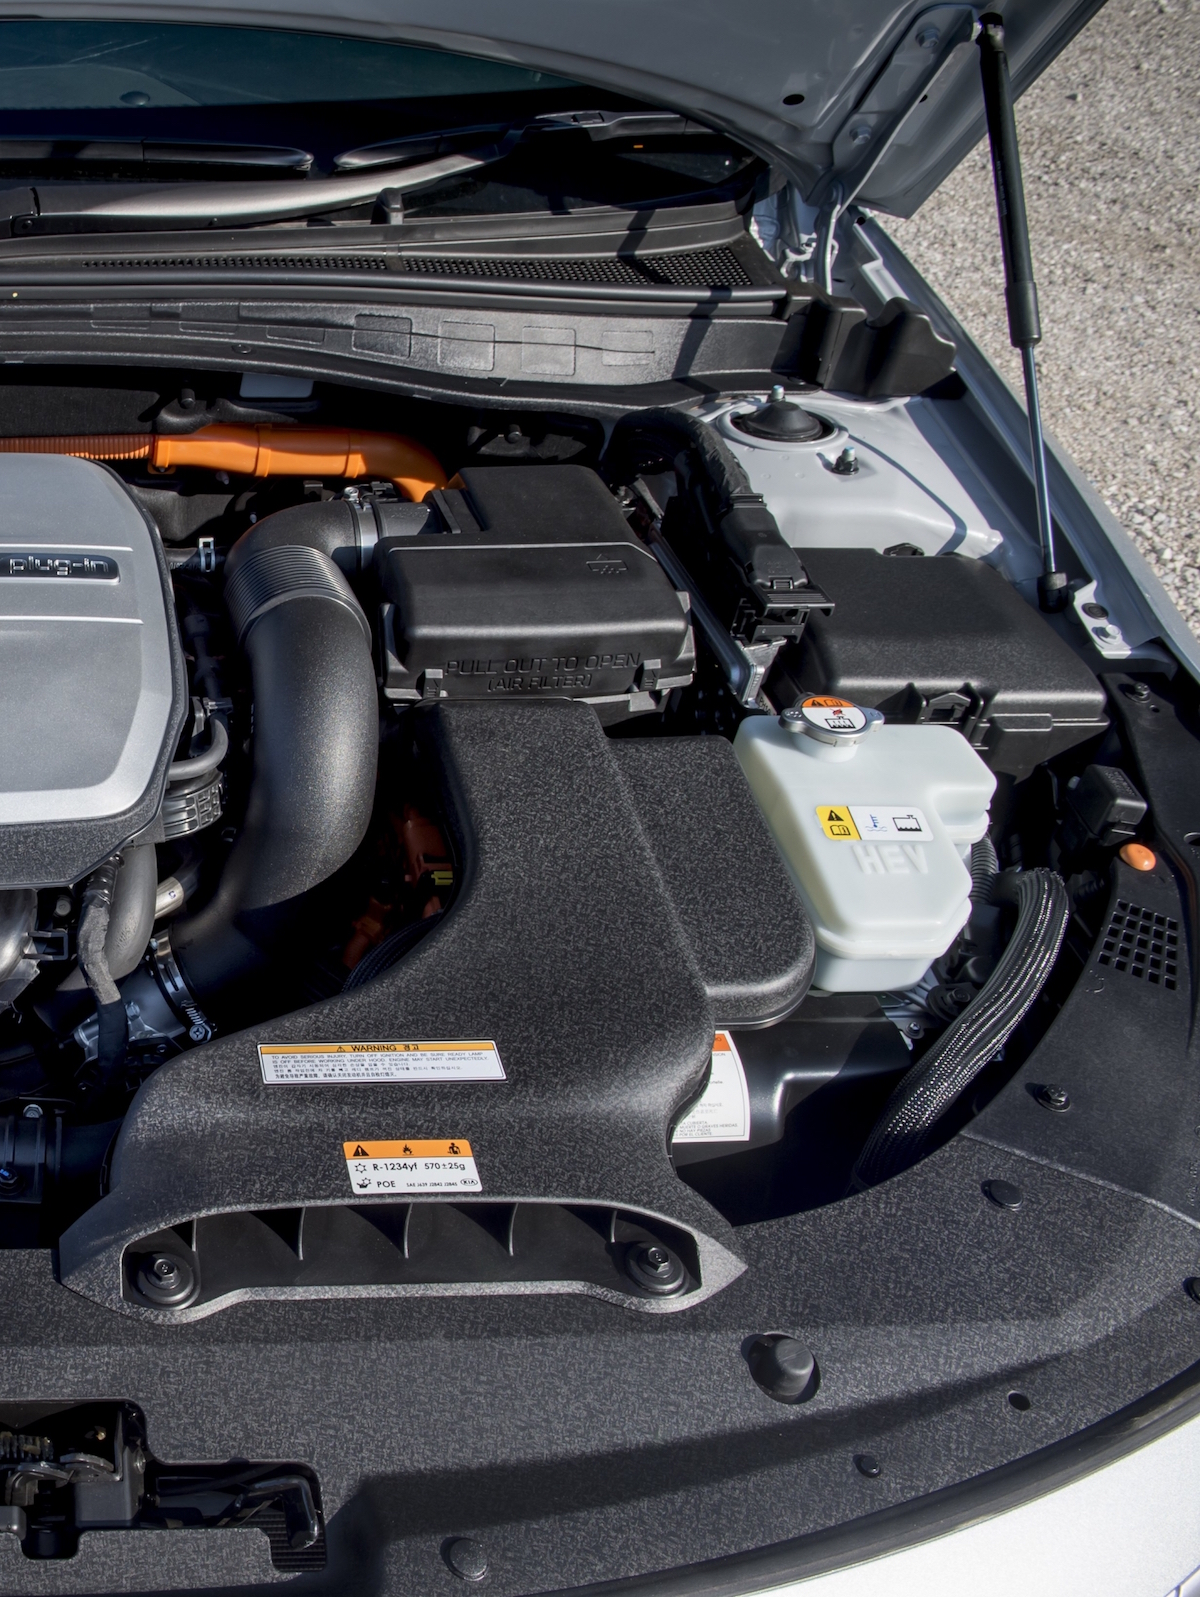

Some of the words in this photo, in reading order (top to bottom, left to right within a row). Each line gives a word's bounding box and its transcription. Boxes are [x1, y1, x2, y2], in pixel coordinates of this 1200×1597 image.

[9, 555, 109, 576] plug-in
[445, 659, 497, 676] PULL
[504, 658, 547, 674] OUT
[554, 656, 578, 672] TO
[584, 652, 640, 670] OPEN
[528, 674, 593, 690] FILTER)
[851, 844, 929, 875] HEV
[351, 1044, 397, 1052] WARNING
[372, 1162, 418, 1172] R-1234yf
